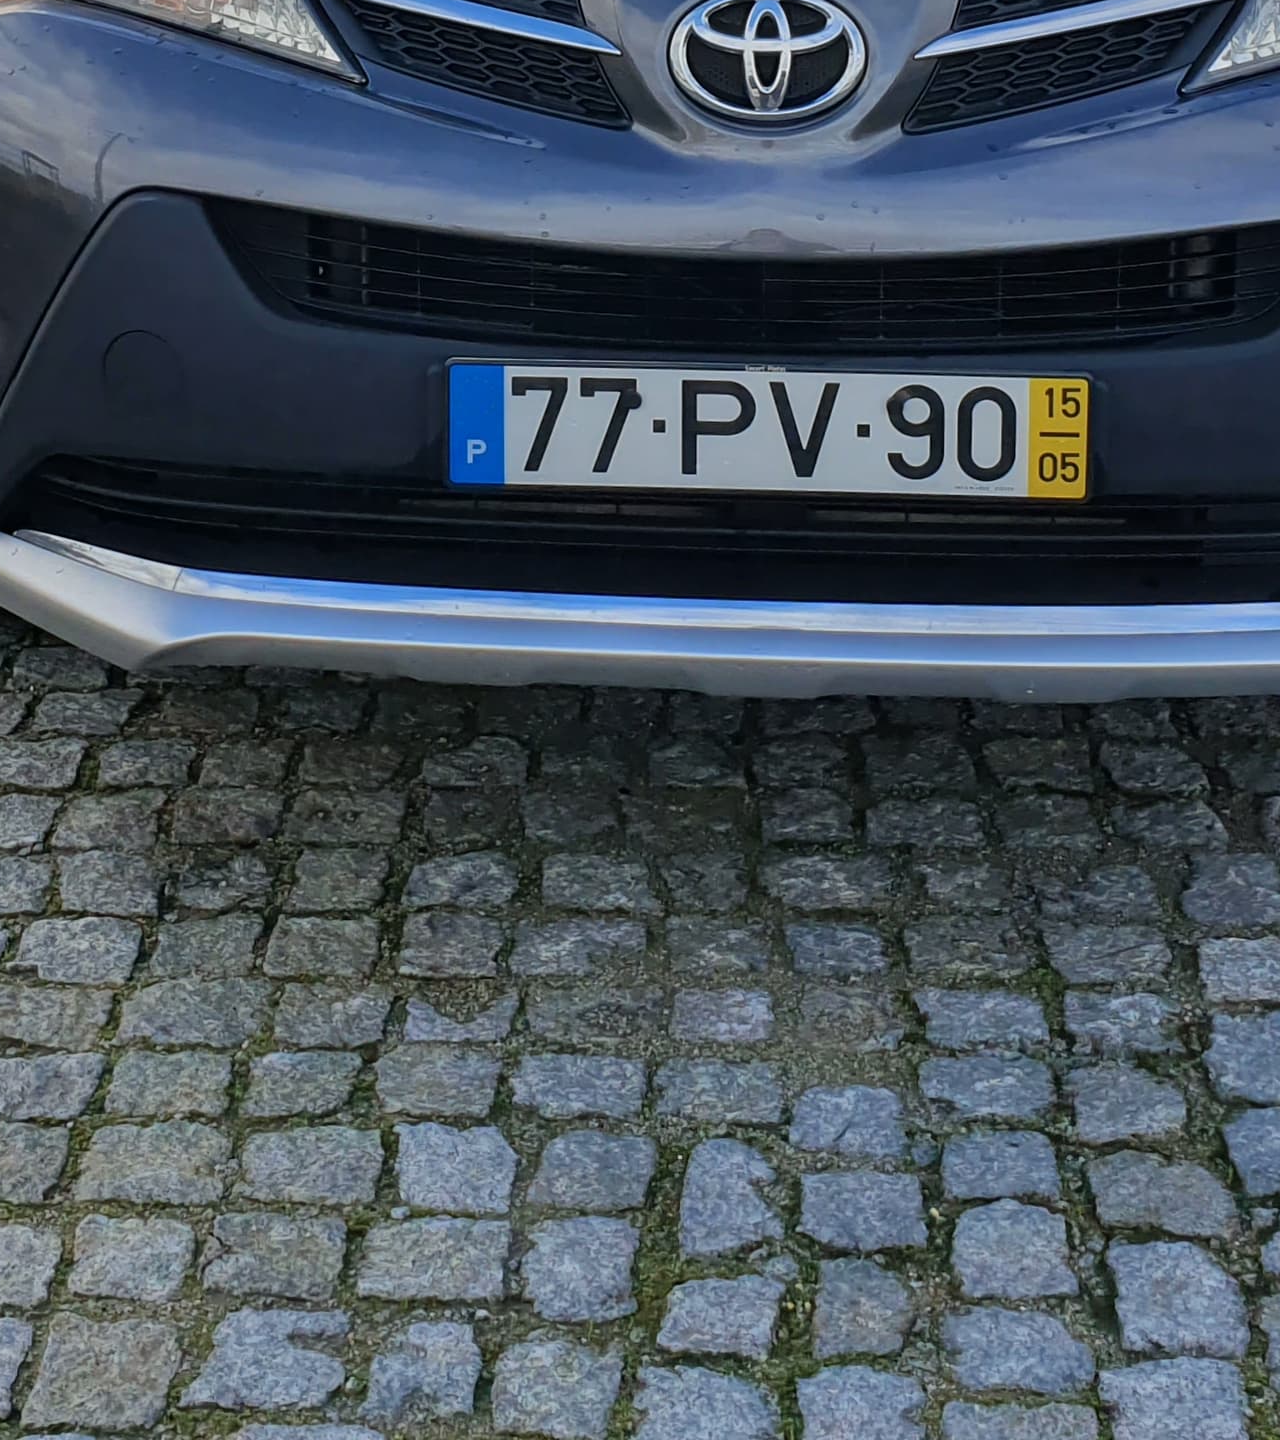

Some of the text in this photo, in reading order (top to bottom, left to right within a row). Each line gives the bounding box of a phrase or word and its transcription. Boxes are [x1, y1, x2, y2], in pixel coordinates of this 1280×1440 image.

[1043, 387, 1081, 418] 15
[467, 439, 487, 464] P
[1038, 452, 1080, 483] 05
